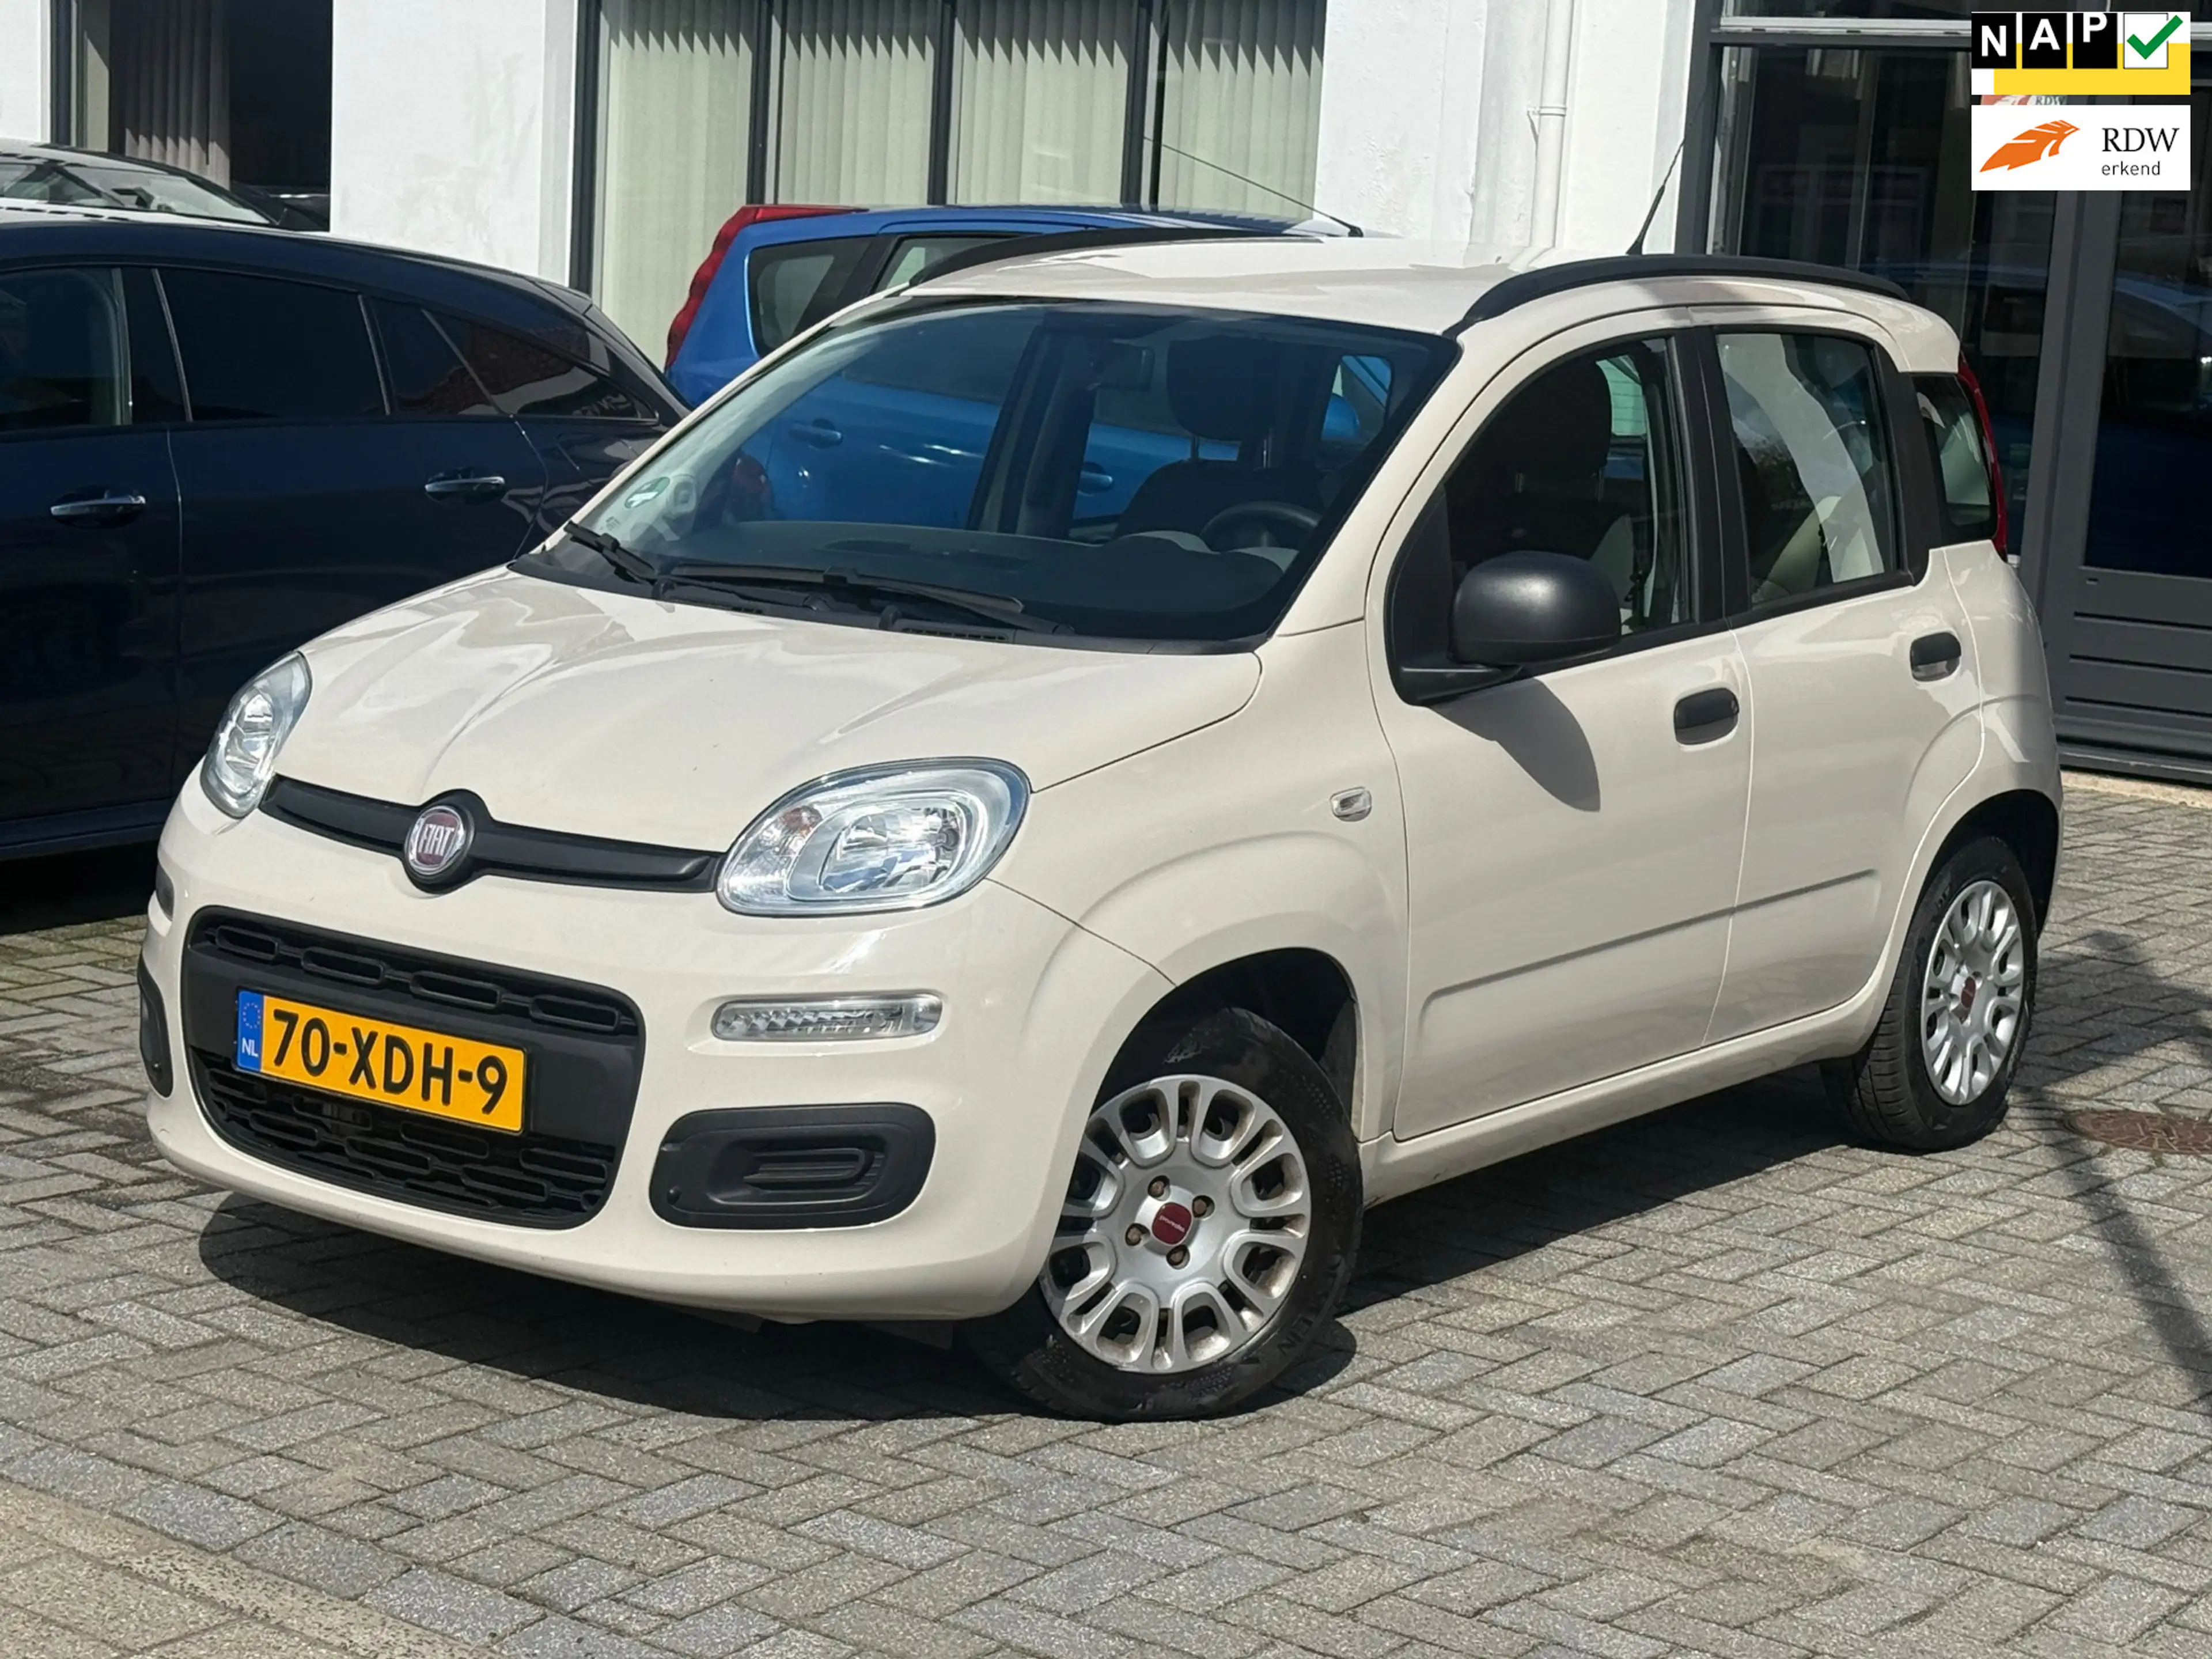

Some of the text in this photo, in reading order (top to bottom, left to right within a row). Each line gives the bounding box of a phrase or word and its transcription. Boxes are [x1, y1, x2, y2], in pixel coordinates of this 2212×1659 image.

[418, 823, 455, 857] FIAT
[241, 1037, 260, 1058] NL
[273, 1009, 507, 1115] 70-XDH-9
